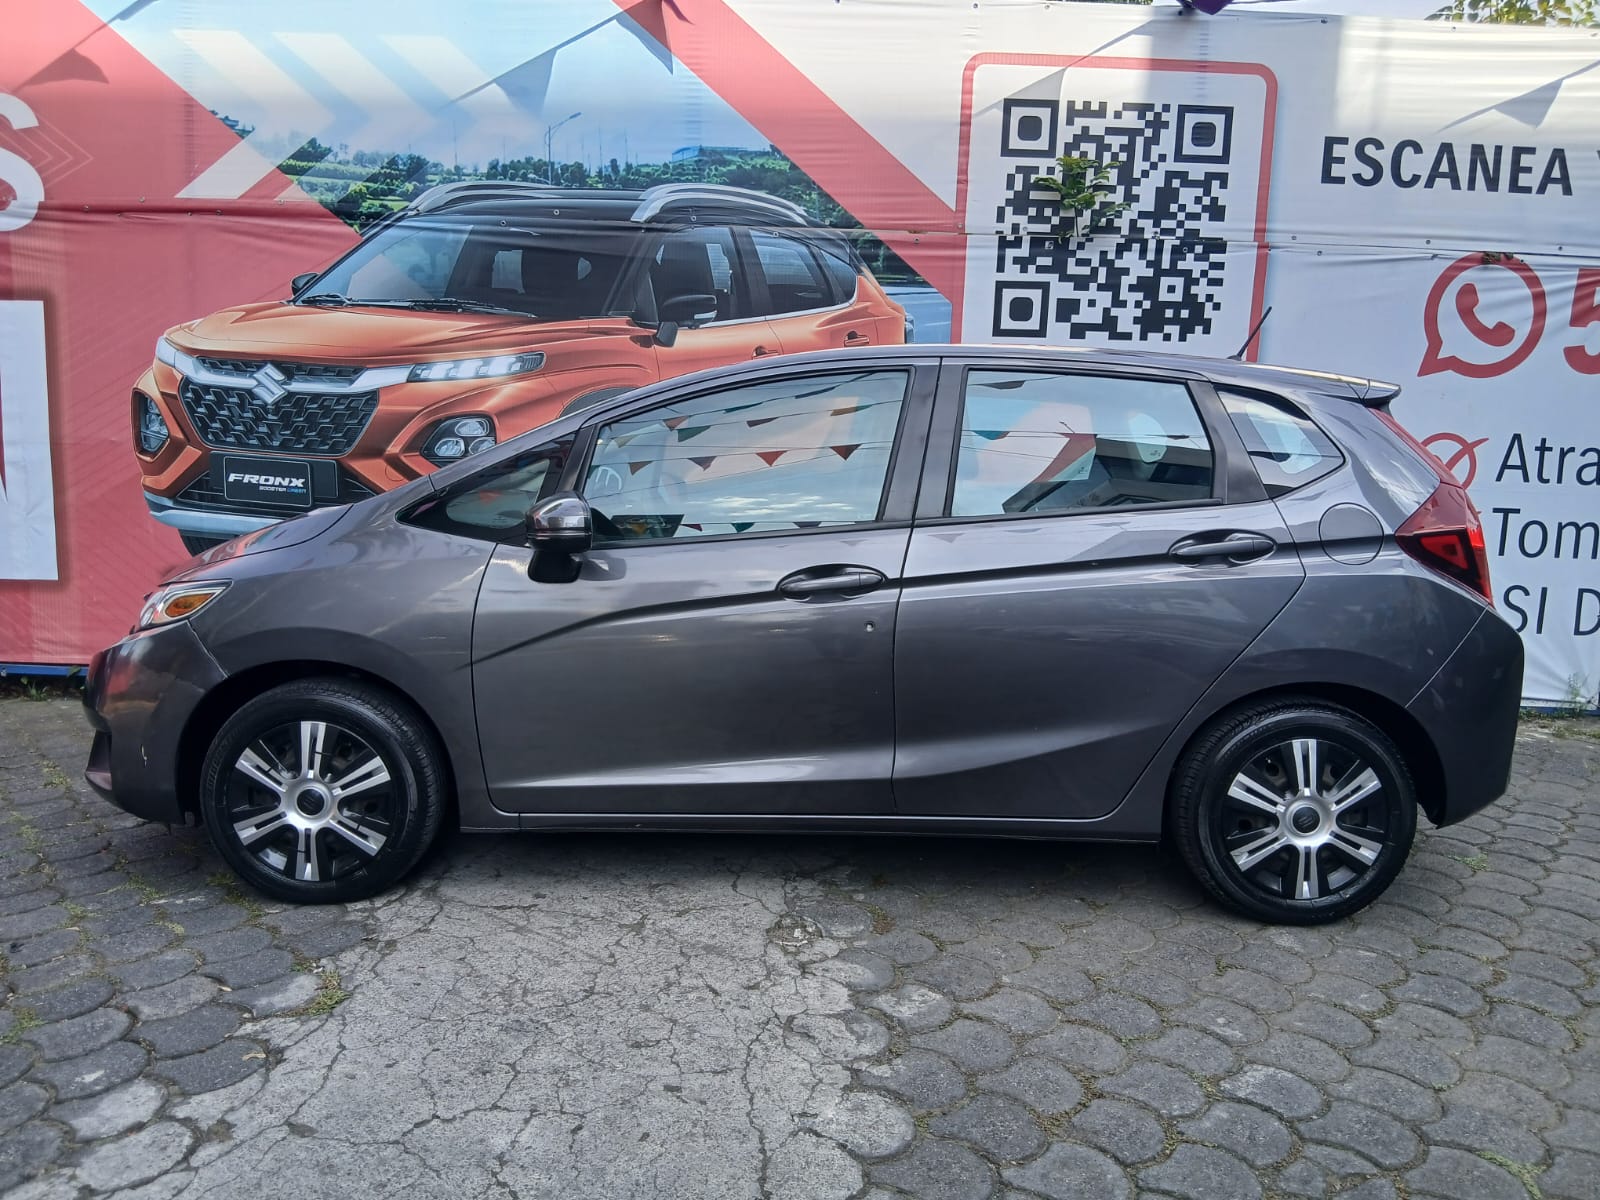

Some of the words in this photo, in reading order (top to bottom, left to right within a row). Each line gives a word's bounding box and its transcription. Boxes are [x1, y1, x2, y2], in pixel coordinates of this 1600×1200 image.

[1321, 136, 1573, 196] ESCANEA
[228, 473, 305, 487] FRONX
[1495, 433, 1600, 486] Atra
[1492, 507, 1600, 560] Tom
[1503, 584, 1548, 635] SI
